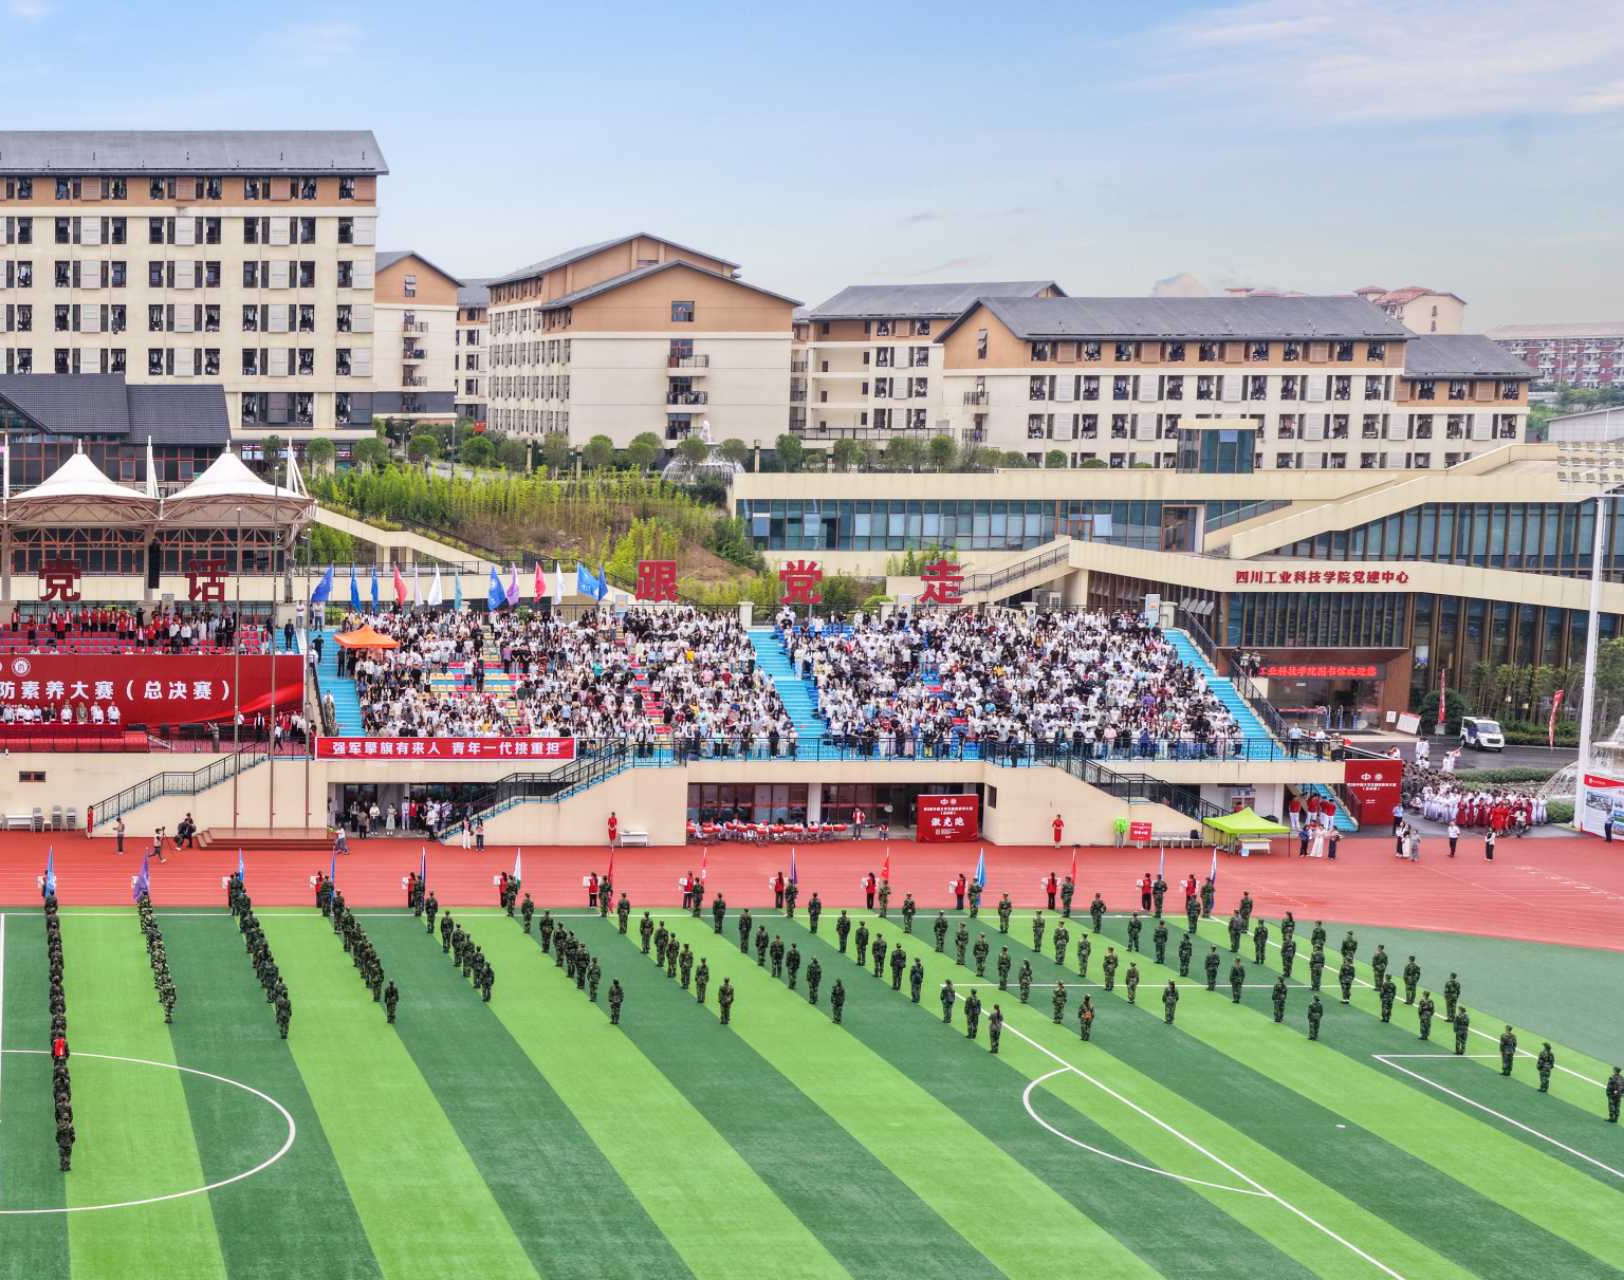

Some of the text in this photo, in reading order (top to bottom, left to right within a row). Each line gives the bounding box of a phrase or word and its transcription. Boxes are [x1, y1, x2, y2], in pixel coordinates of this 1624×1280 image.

[1235, 570, 1409, 584] 四川工业科技学院党建中心
[451, 741, 560, 755] 青年一代挑重担
